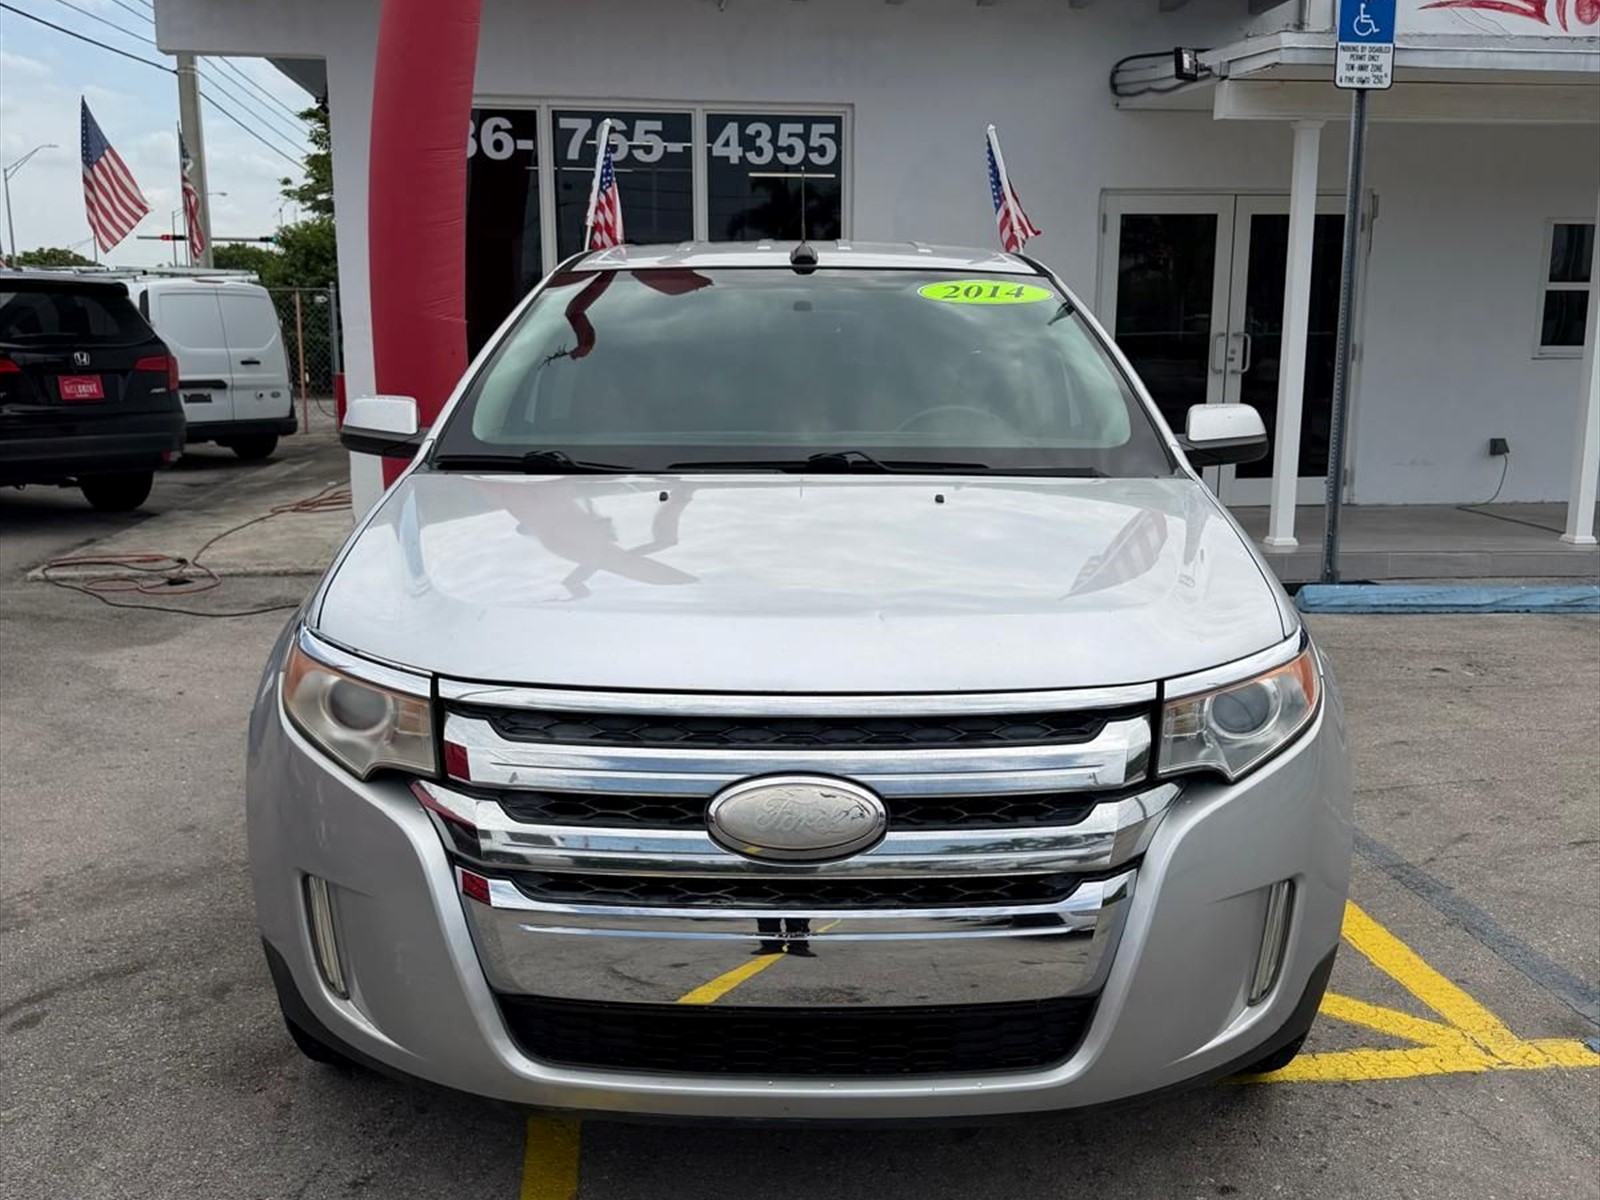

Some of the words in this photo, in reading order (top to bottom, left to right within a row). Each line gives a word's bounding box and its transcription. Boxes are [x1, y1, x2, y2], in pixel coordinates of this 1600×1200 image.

[1368, 45, 1391, 54] DISABLED
[1349, 54, 1367, 62] PERMIT
[1370, 63, 1383, 73] ZONE
[711, 121, 836, 166] 4355
[942, 285, 1025, 299] 2014
